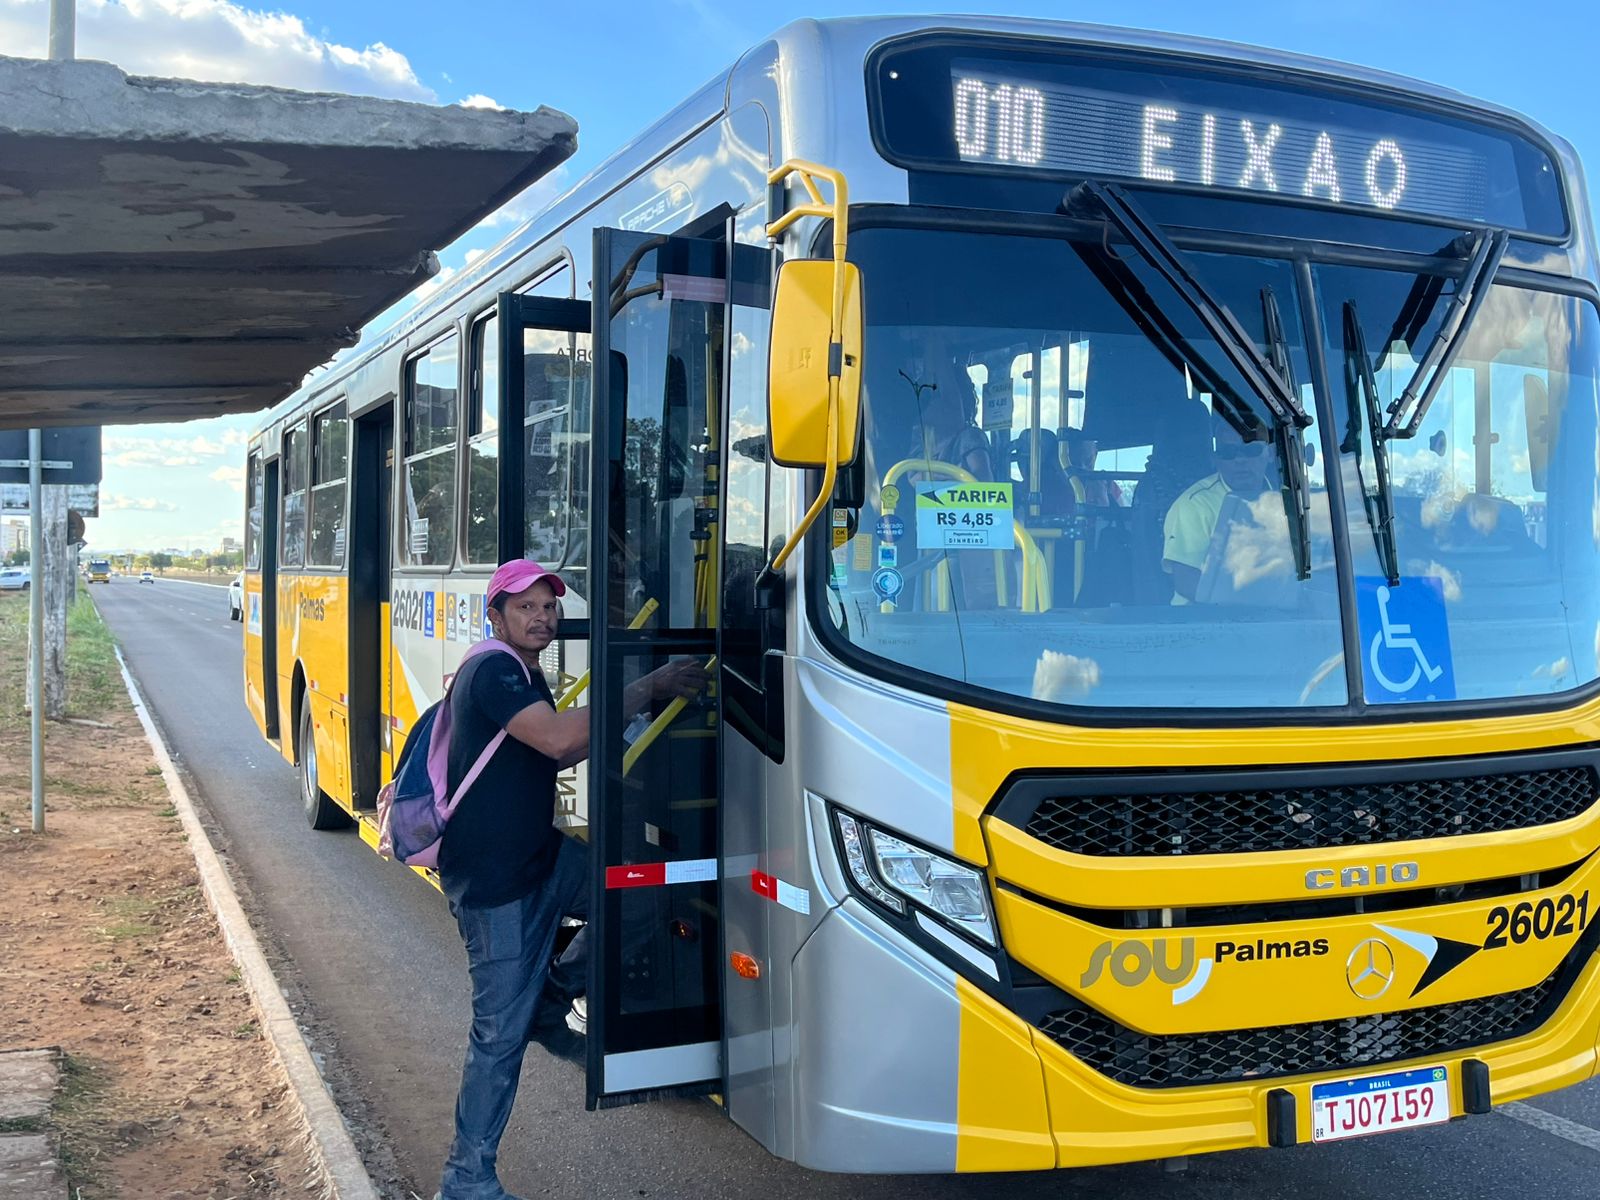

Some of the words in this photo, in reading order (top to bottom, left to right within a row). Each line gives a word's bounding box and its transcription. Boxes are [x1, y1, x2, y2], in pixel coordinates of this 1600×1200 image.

[954, 77, 1046, 165] 010
[1140, 104, 1408, 210] EIXAO
[947, 489, 1008, 503] TARIFA
[936, 512, 957, 527] R$
[961, 512, 994, 529] 4,85
[300, 591, 325, 622] Palmas
[393, 589, 424, 631] 26021
[1304, 861, 1419, 890] CAIO
[1483, 890, 1590, 951] 26021
[1215, 938, 1330, 963] Palmas
[1369, 1080, 1391, 1090] BRASIL
